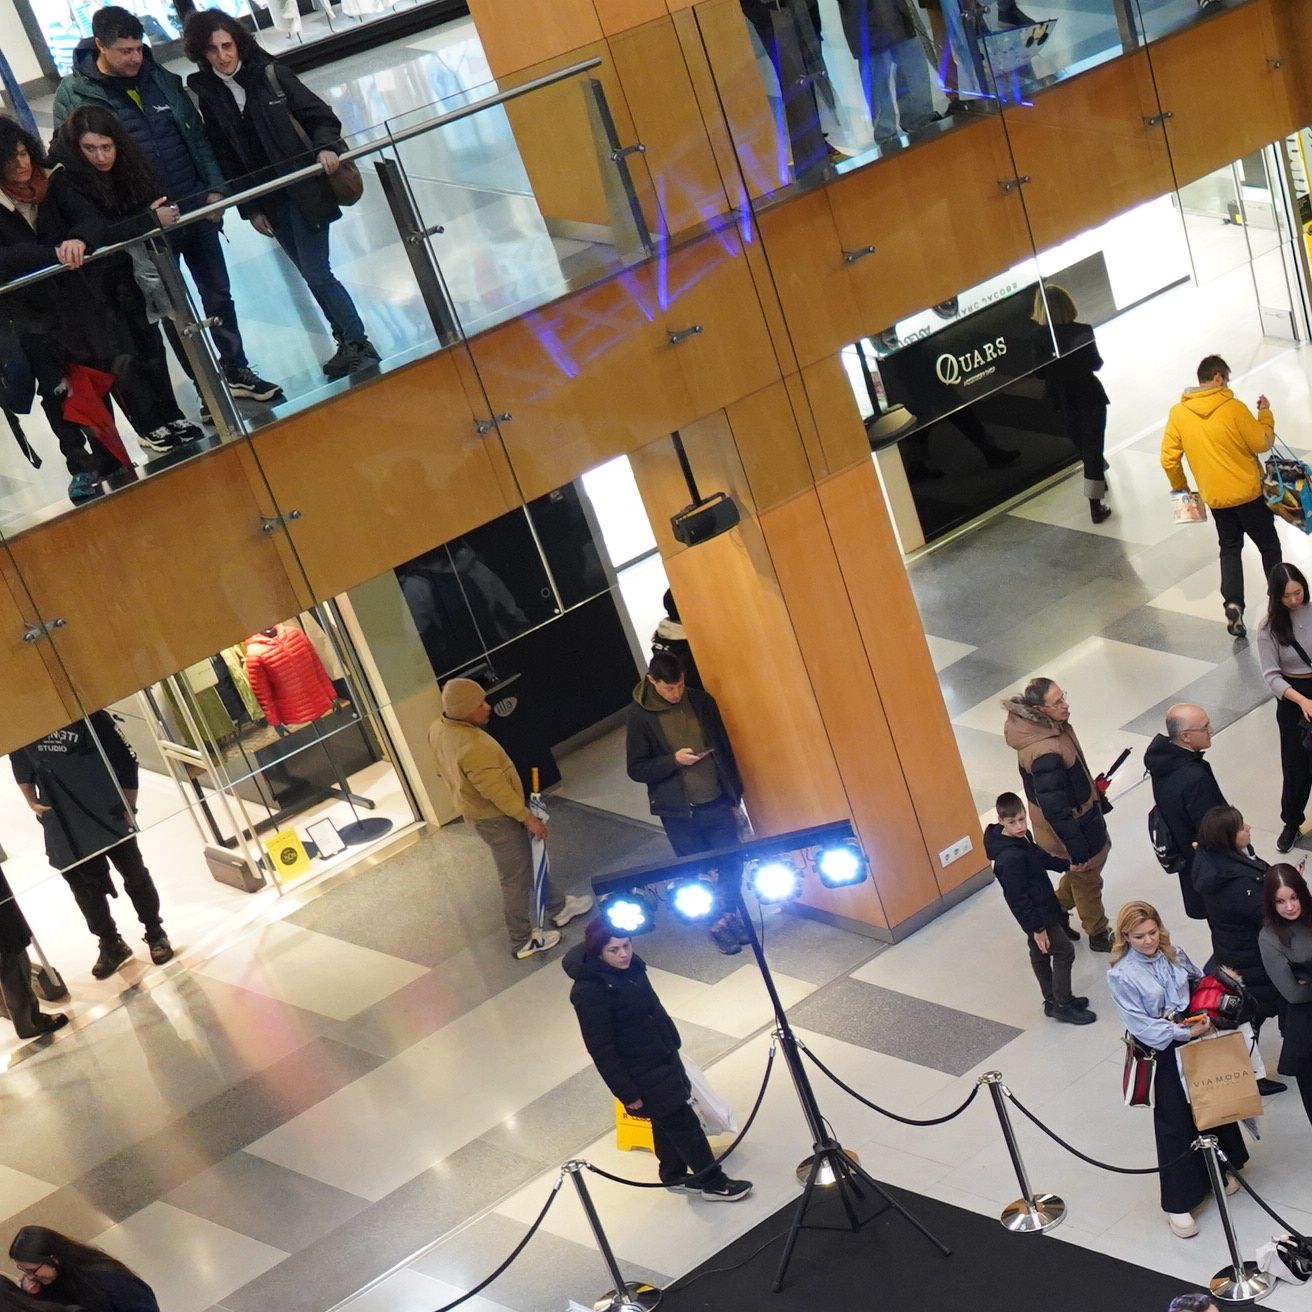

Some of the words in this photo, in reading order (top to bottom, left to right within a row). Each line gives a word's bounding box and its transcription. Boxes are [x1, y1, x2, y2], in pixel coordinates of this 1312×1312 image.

[935, 336, 1008, 386] QUARS
[48, 730, 79, 743] NGTI
[37, 744, 68, 753] STUDIO
